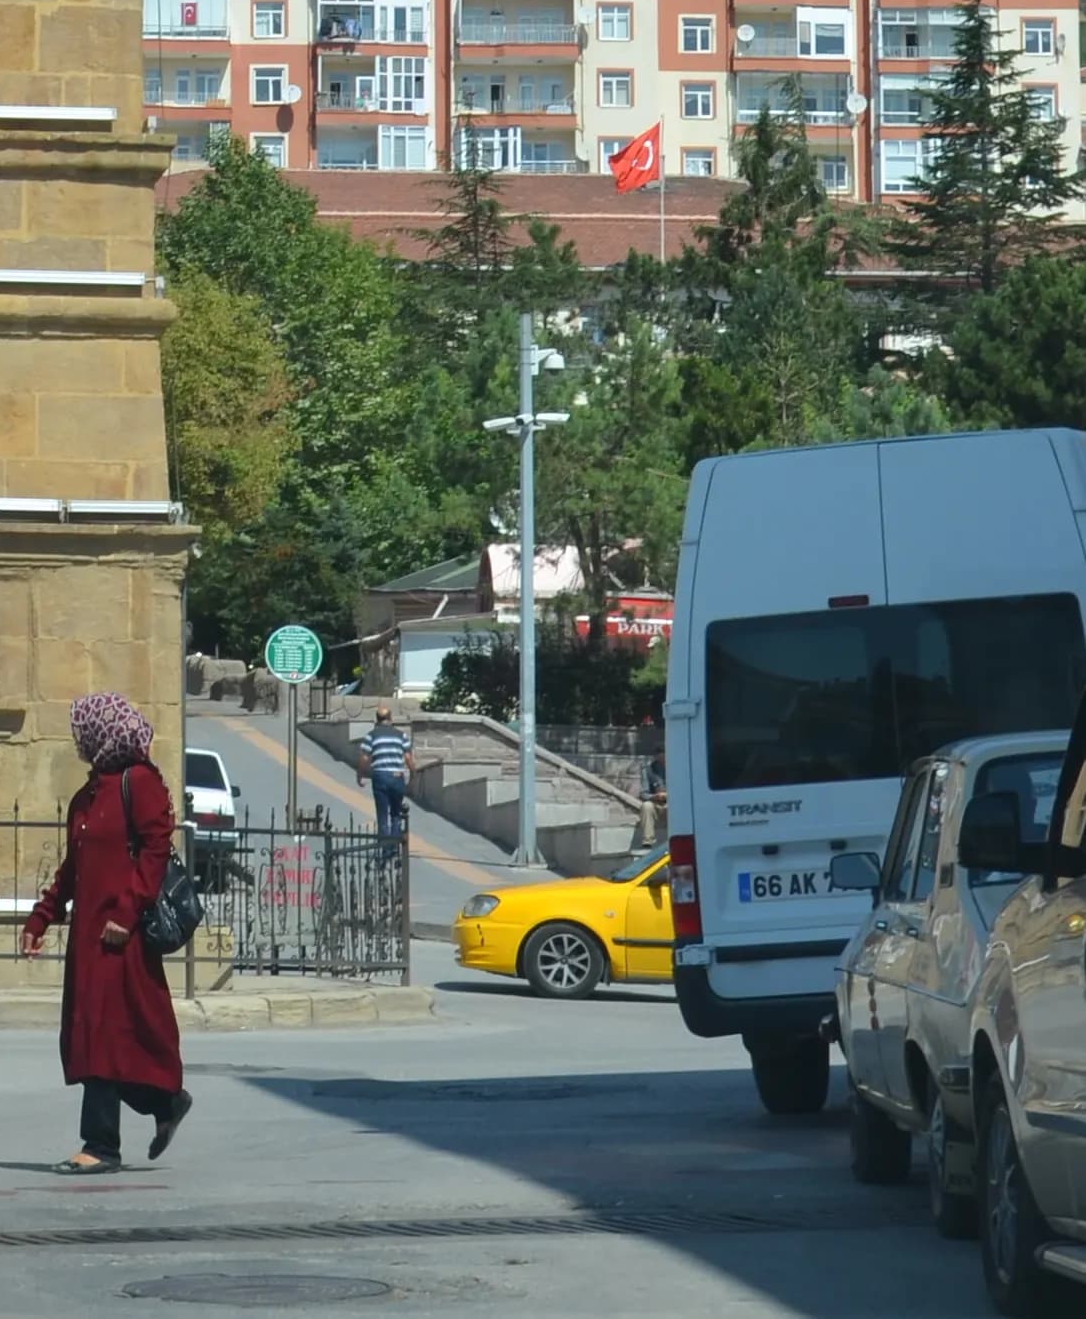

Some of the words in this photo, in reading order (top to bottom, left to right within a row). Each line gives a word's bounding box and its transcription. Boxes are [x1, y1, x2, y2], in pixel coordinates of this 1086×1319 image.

[727, 799, 802, 816] TRANSIT
[753, 875, 782, 898] 66
[789, 872, 817, 895] AK
